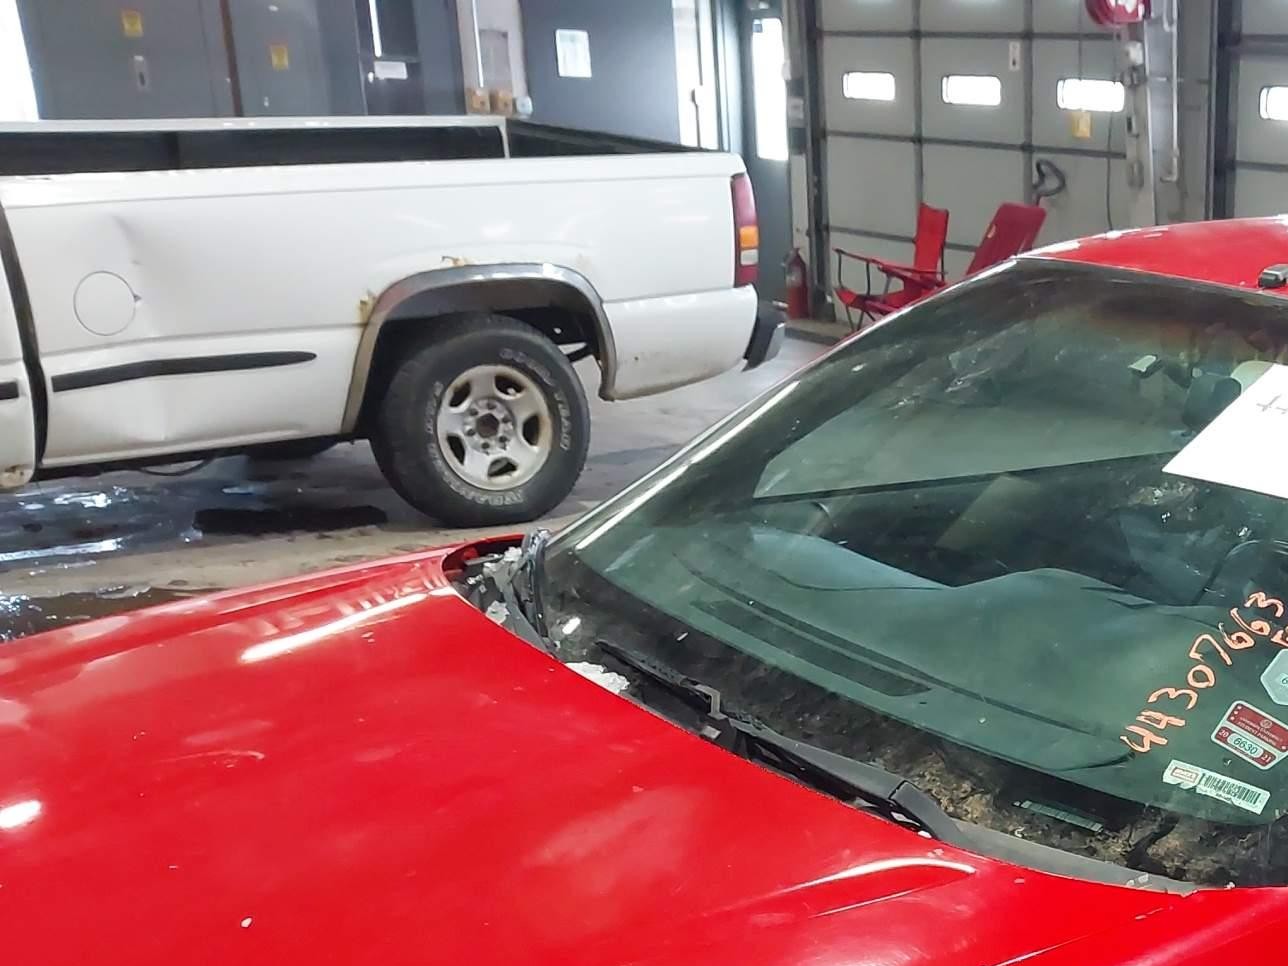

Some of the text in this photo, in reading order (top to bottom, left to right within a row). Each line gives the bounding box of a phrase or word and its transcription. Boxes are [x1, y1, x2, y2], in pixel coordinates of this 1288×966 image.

[1119, 590, 1286, 754] 44307663
[1218, 729, 1230, 739] 20
[1233, 737, 1259, 755] 6630
